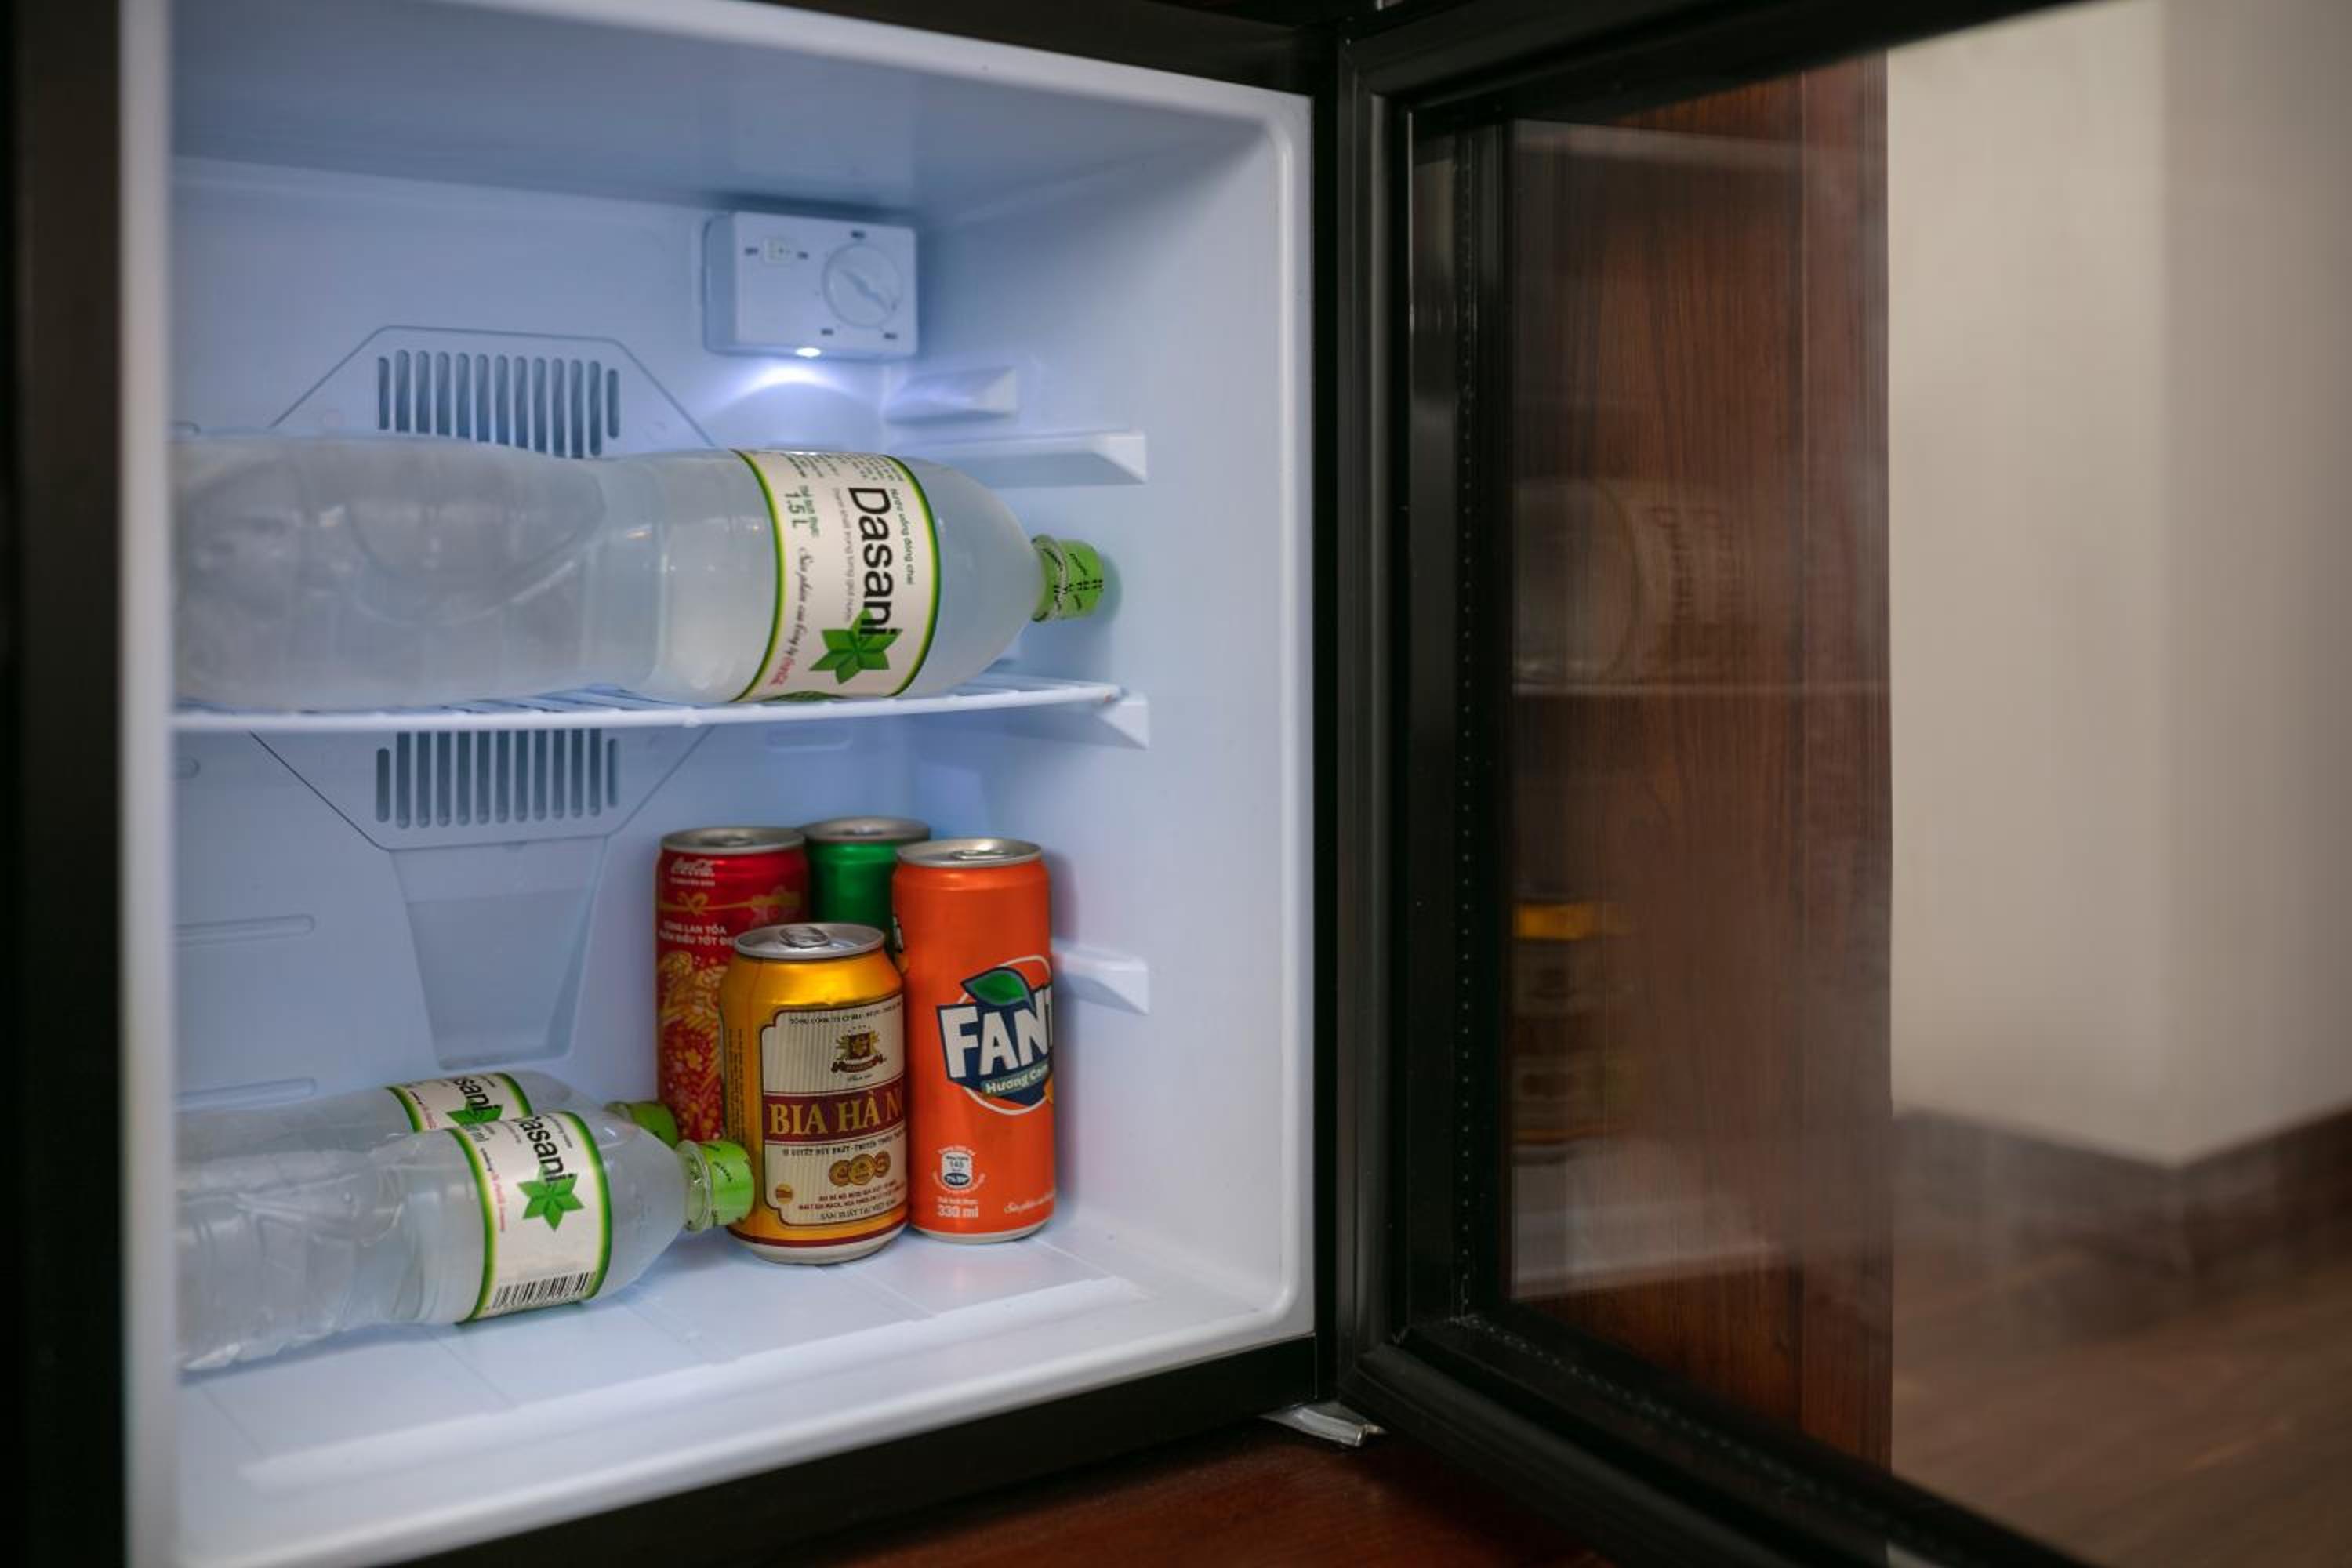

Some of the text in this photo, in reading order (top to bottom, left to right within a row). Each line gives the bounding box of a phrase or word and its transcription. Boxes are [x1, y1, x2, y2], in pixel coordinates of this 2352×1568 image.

[785, 492, 810, 528] 1.5 L
[848, 487, 897, 635] Dasani
[985, 1076, 1029, 1094] Hương
[768, 1103, 828, 1135] BIA
[837, 1090, 880, 1132] HÀ
[514, 1116, 574, 1182] asani
